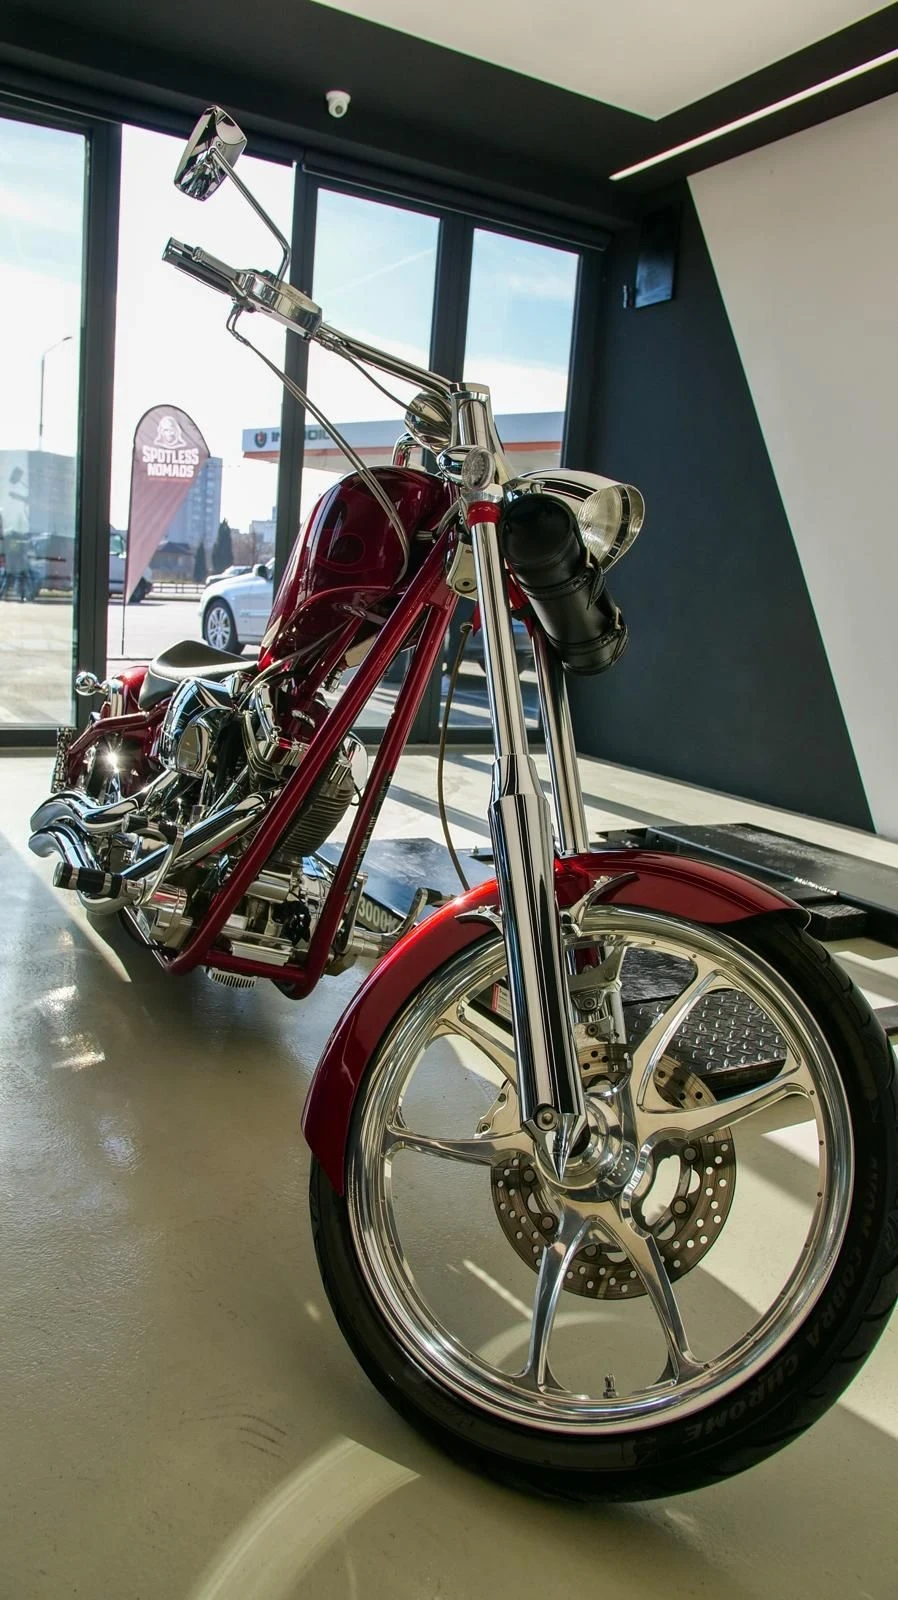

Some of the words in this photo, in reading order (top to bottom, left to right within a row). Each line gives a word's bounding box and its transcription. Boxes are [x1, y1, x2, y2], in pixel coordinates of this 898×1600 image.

[142, 445, 200, 466] SPOTLESS
[147, 463, 195, 478] NOMADS
[684, 1353, 800, 1443] CHROME
